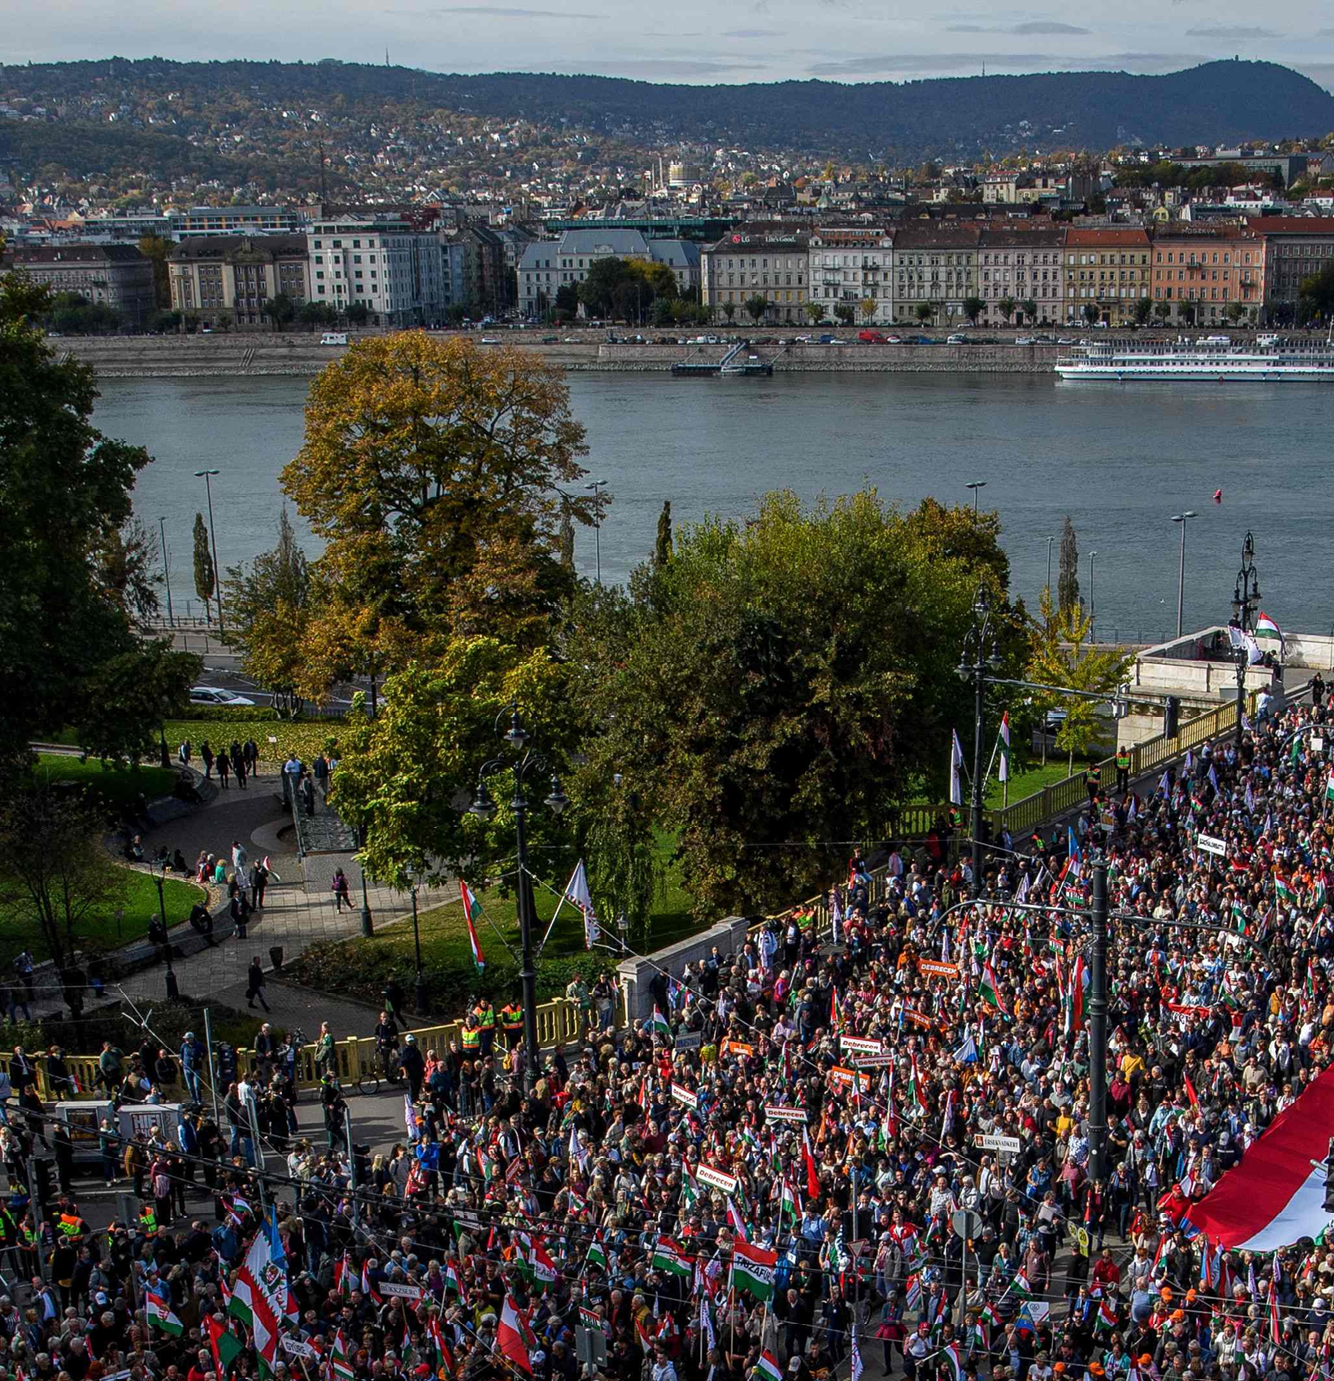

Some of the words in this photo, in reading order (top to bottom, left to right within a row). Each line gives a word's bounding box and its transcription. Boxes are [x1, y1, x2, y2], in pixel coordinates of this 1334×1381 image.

[921, 964, 957, 975] DEBRECEN
[843, 1040, 879, 1050] Debrecen
[768, 1110, 804, 1119] Debrecen
[134, 1114, 161, 1128] HIFI
[699, 1169, 734, 1188] Debrecen
